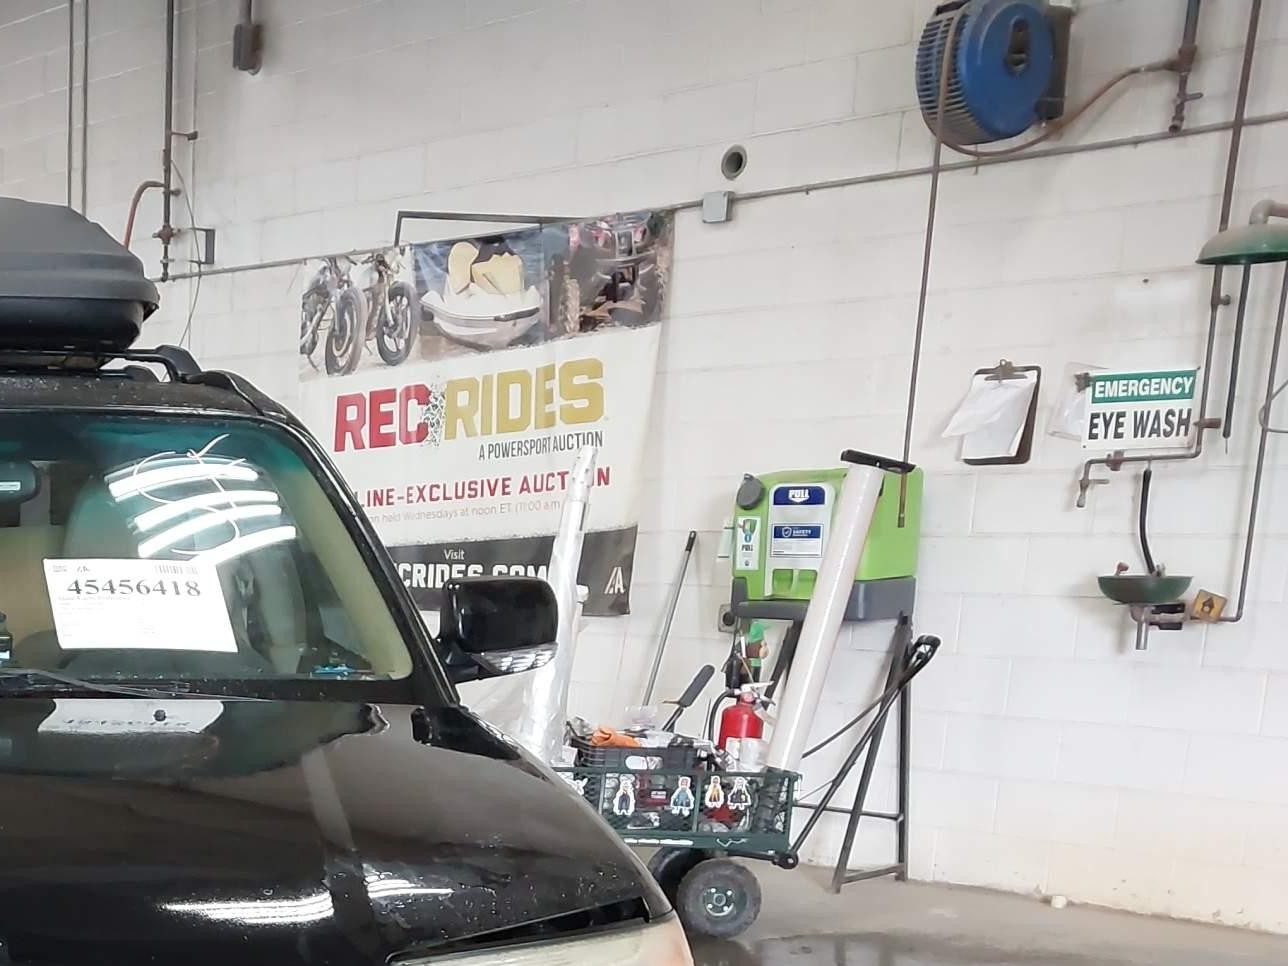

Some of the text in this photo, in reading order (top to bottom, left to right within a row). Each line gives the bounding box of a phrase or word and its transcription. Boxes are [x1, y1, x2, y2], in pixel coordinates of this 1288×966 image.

[1095, 377, 1193, 398] EMERGENCY
[334, 358, 604, 452] REC RIDES
[1088, 408, 1192, 440] EYE WASH
[479, 431, 603, 461] A POWERSPORT AUCTION
[519, 467, 610, 494] AUCTN
[500, 502, 511, 514] ET
[444, 549, 464, 560] Visit
[67, 579, 201, 597] 45456418
